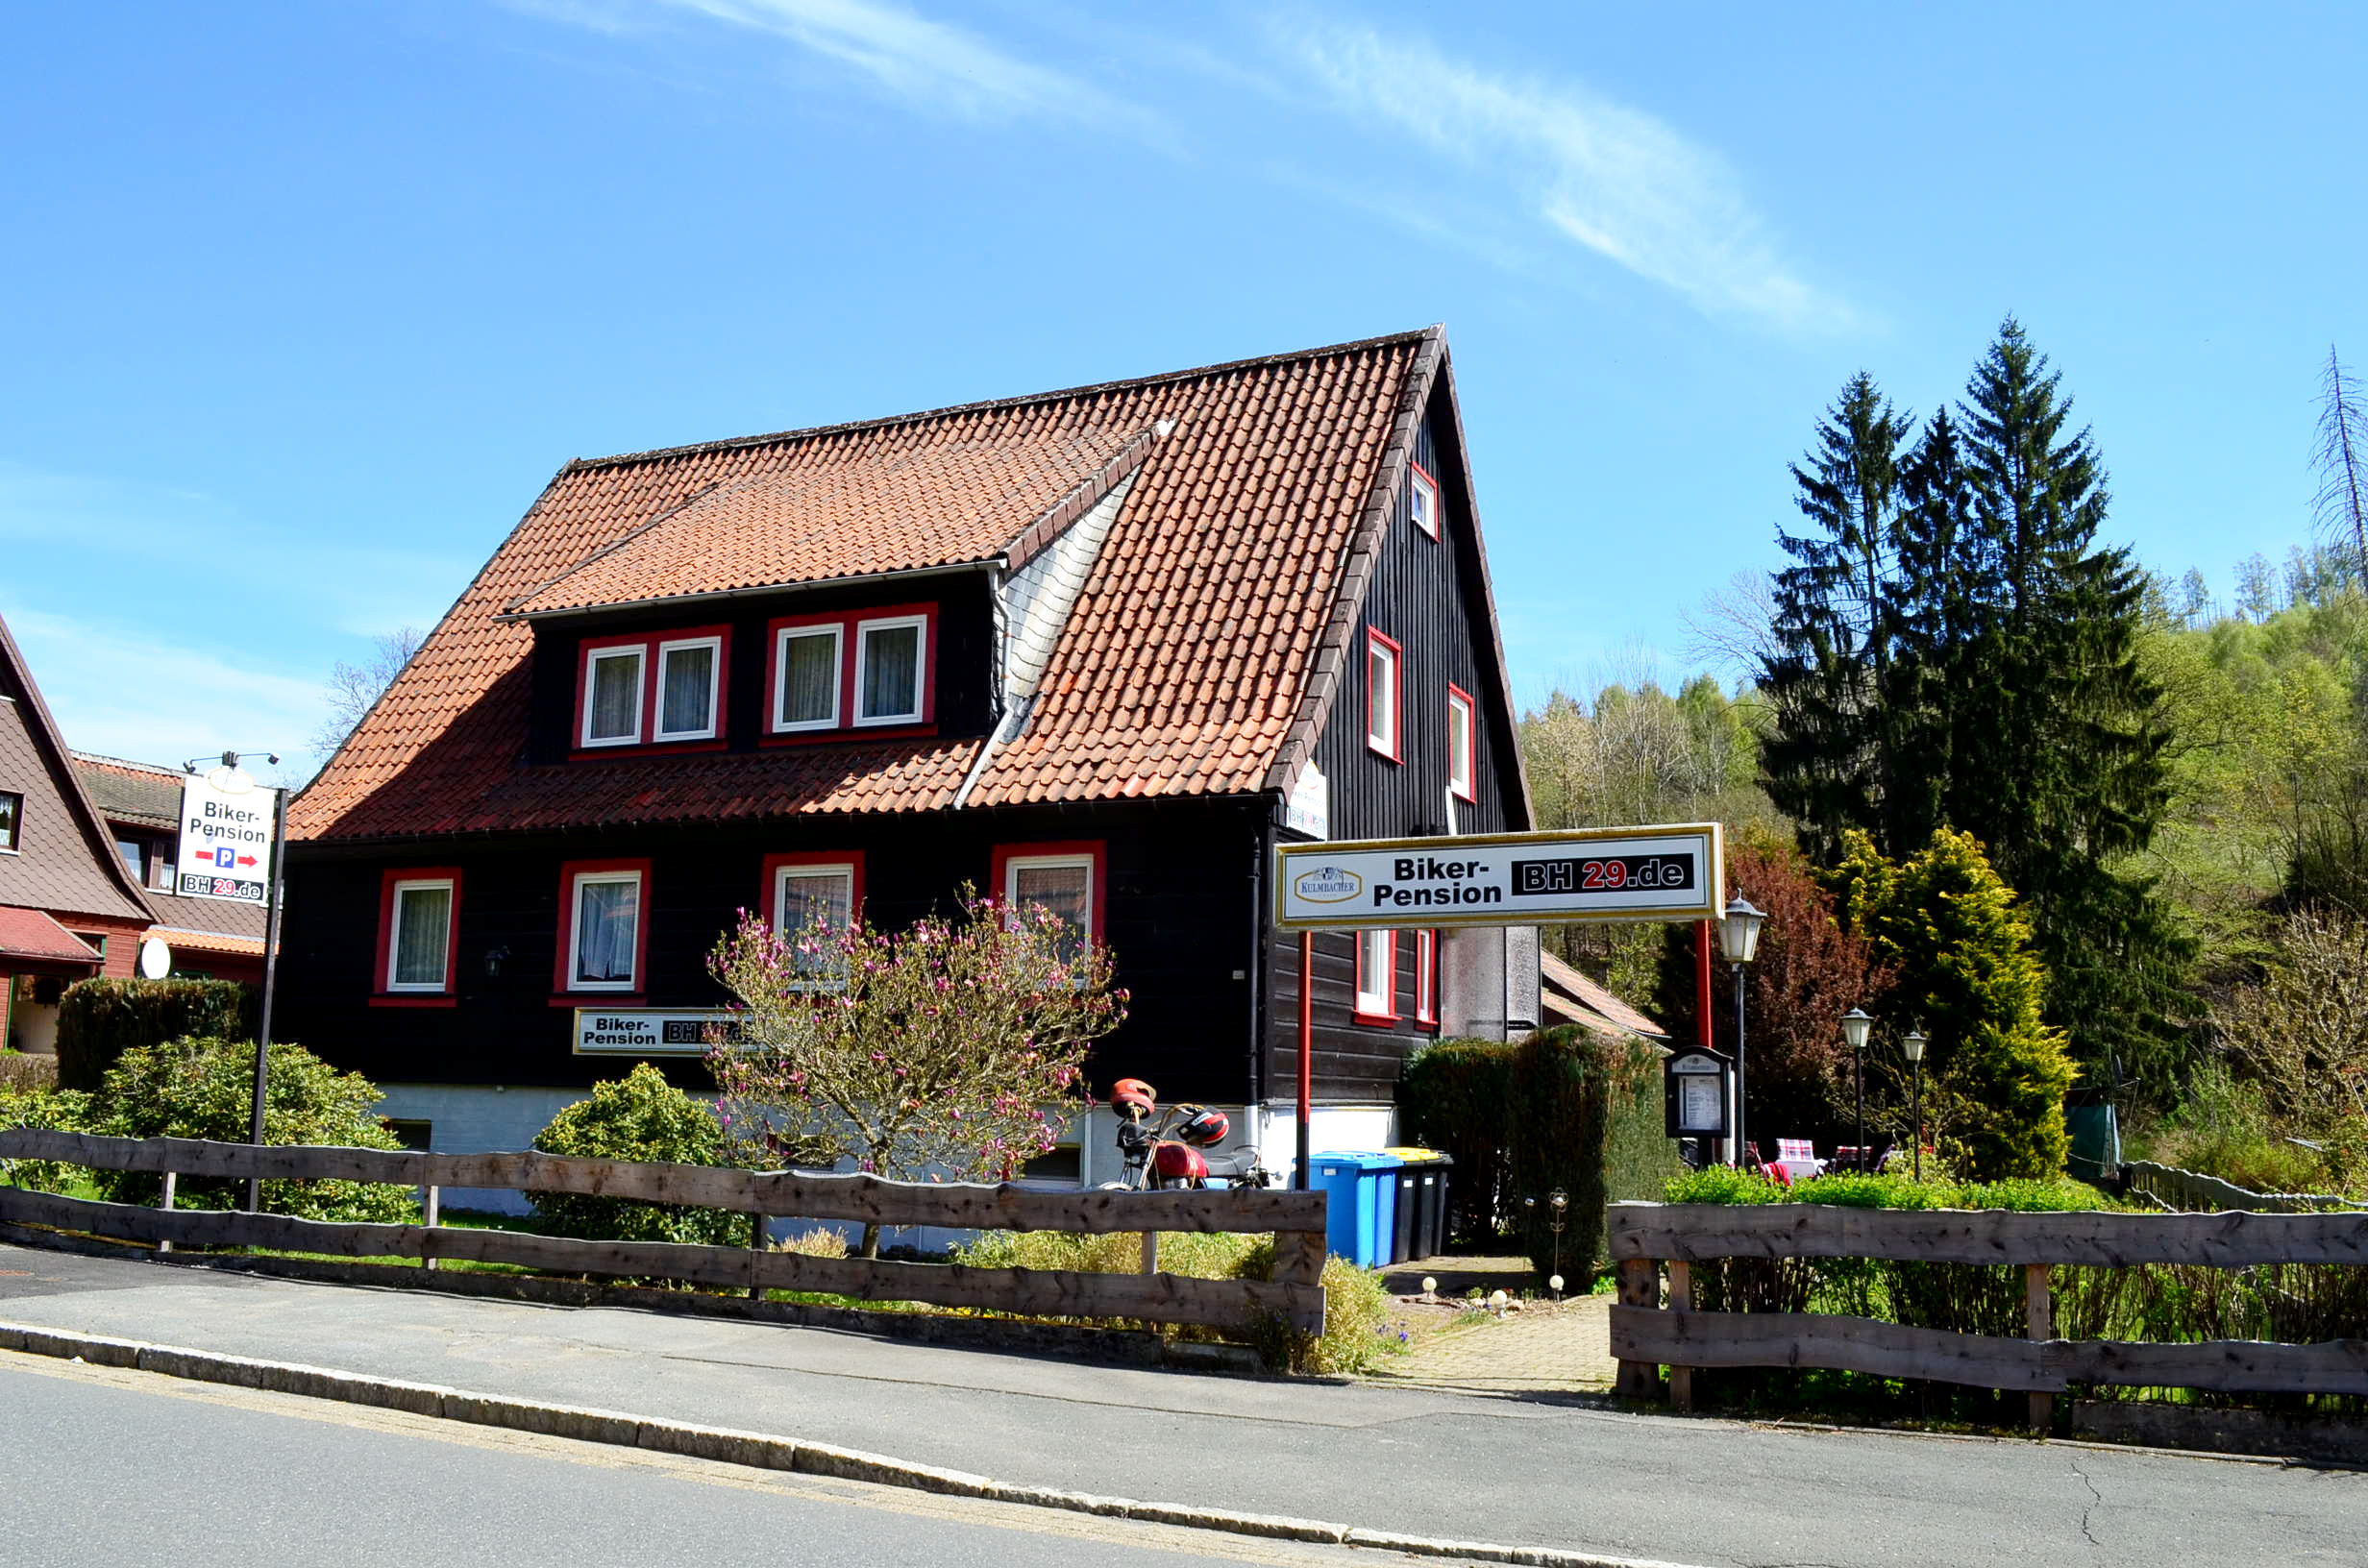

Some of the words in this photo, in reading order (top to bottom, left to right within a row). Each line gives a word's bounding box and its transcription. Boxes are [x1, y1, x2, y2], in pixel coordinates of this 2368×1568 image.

[205, 801, 259, 822] Biker-
[190, 818, 265, 843] Pension
[1394, 857, 1490, 881] Biker-
[1523, 863, 1573, 891] BH
[1582, 858, 1685, 889] 29.de
[185, 875, 210, 893] BH
[213, 879, 261, 898] 29.de
[1301, 882, 1354, 893] KULMBACHER
[1373, 882, 1501, 907] Pension
[596, 1017, 650, 1031] Biker-
[668, 1022, 697, 1041] BH
[583, 1032, 656, 1045] Pension
